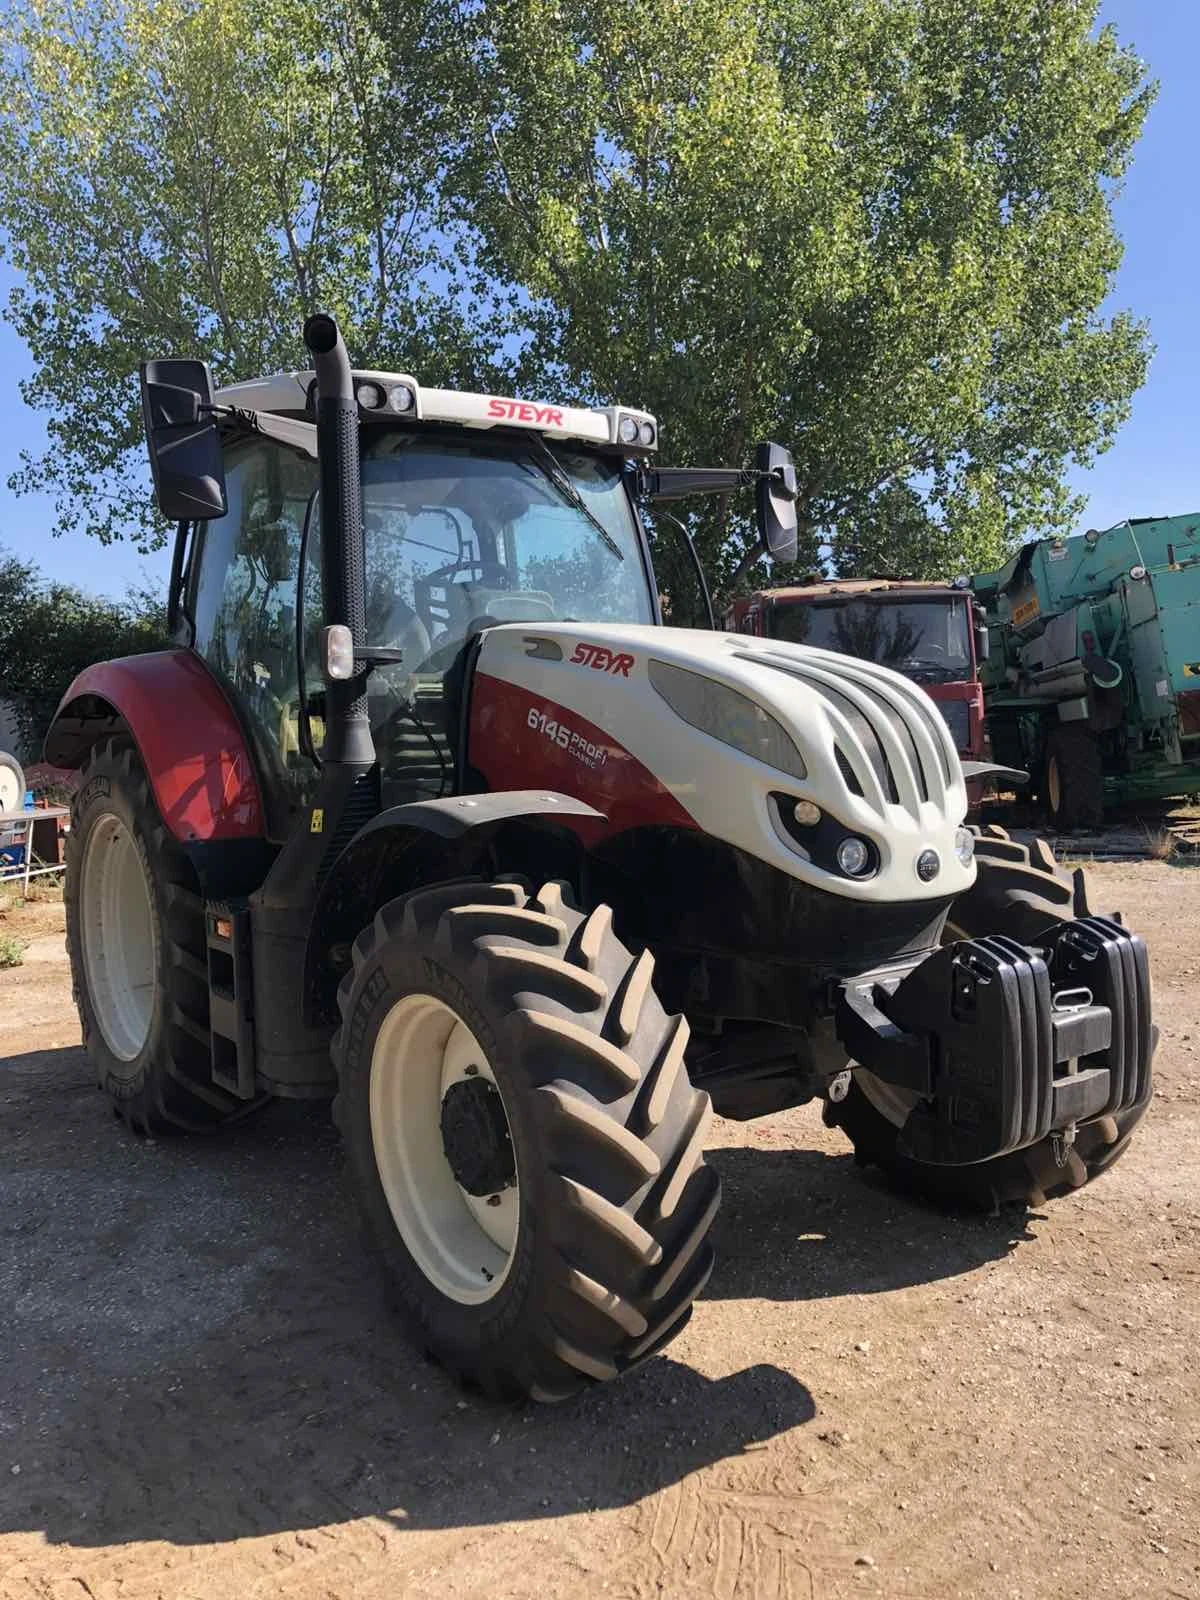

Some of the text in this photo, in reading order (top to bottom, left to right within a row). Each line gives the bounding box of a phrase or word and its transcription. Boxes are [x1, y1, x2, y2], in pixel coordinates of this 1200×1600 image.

[487, 399, 564, 427] STEYR
[569, 642, 635, 678] STEYR
[527, 708, 608, 766] 6145 PROFI
